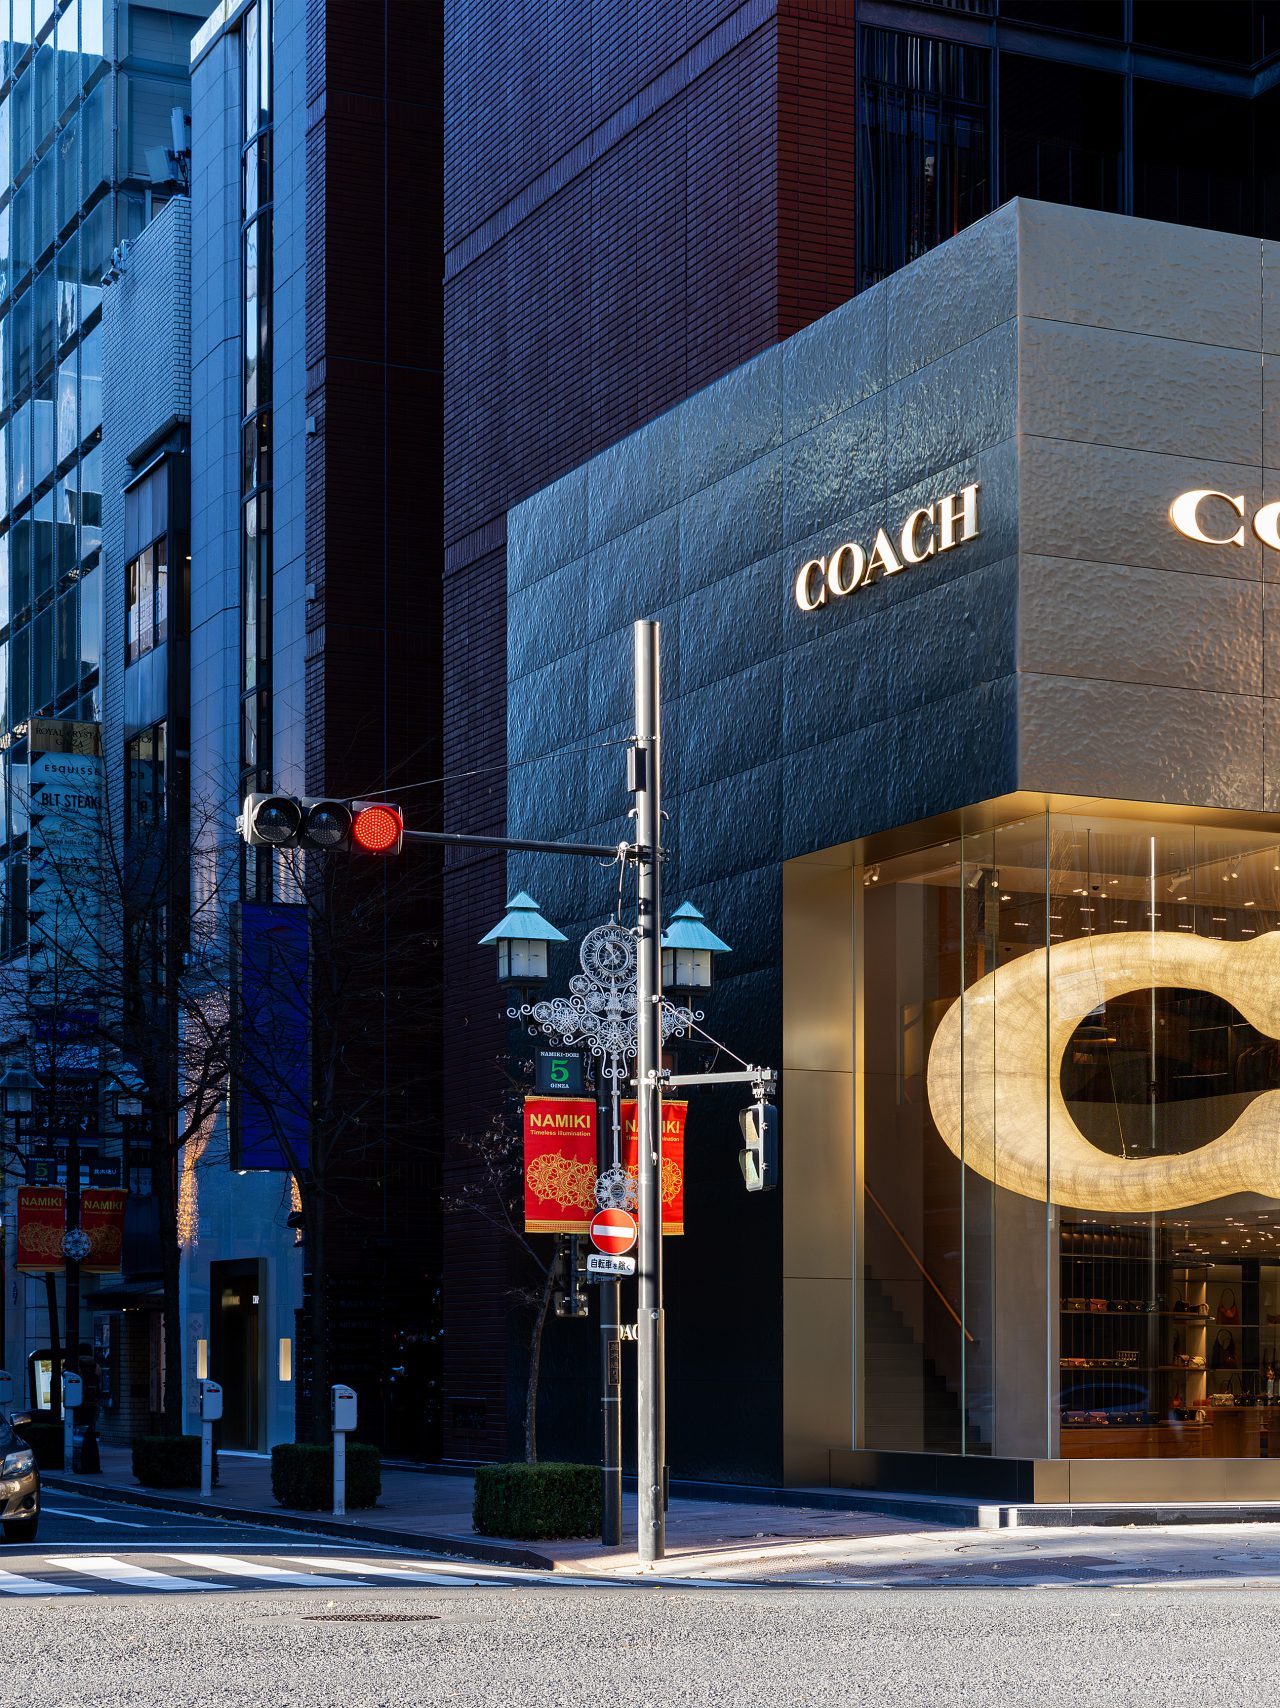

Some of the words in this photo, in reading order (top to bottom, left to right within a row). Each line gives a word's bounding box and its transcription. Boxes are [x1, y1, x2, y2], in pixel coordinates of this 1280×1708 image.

[795, 484, 979, 611] COACH
[36, 728, 64, 738] ROYAL
[44, 764, 101, 776] ESQUISSE
[41, 792, 61, 807] BLT
[64, 796, 101, 810] STEAK
[550, 1059, 569, 1082] 5
[530, 1113, 591, 1129] NAMIKI
[34, 1162, 48, 1177] 5
[21, 1197, 62, 1207] NAMIKI
[84, 1200, 123, 1210] NAMIKI
[590, 1258, 631, 1271] 自転車を除く
